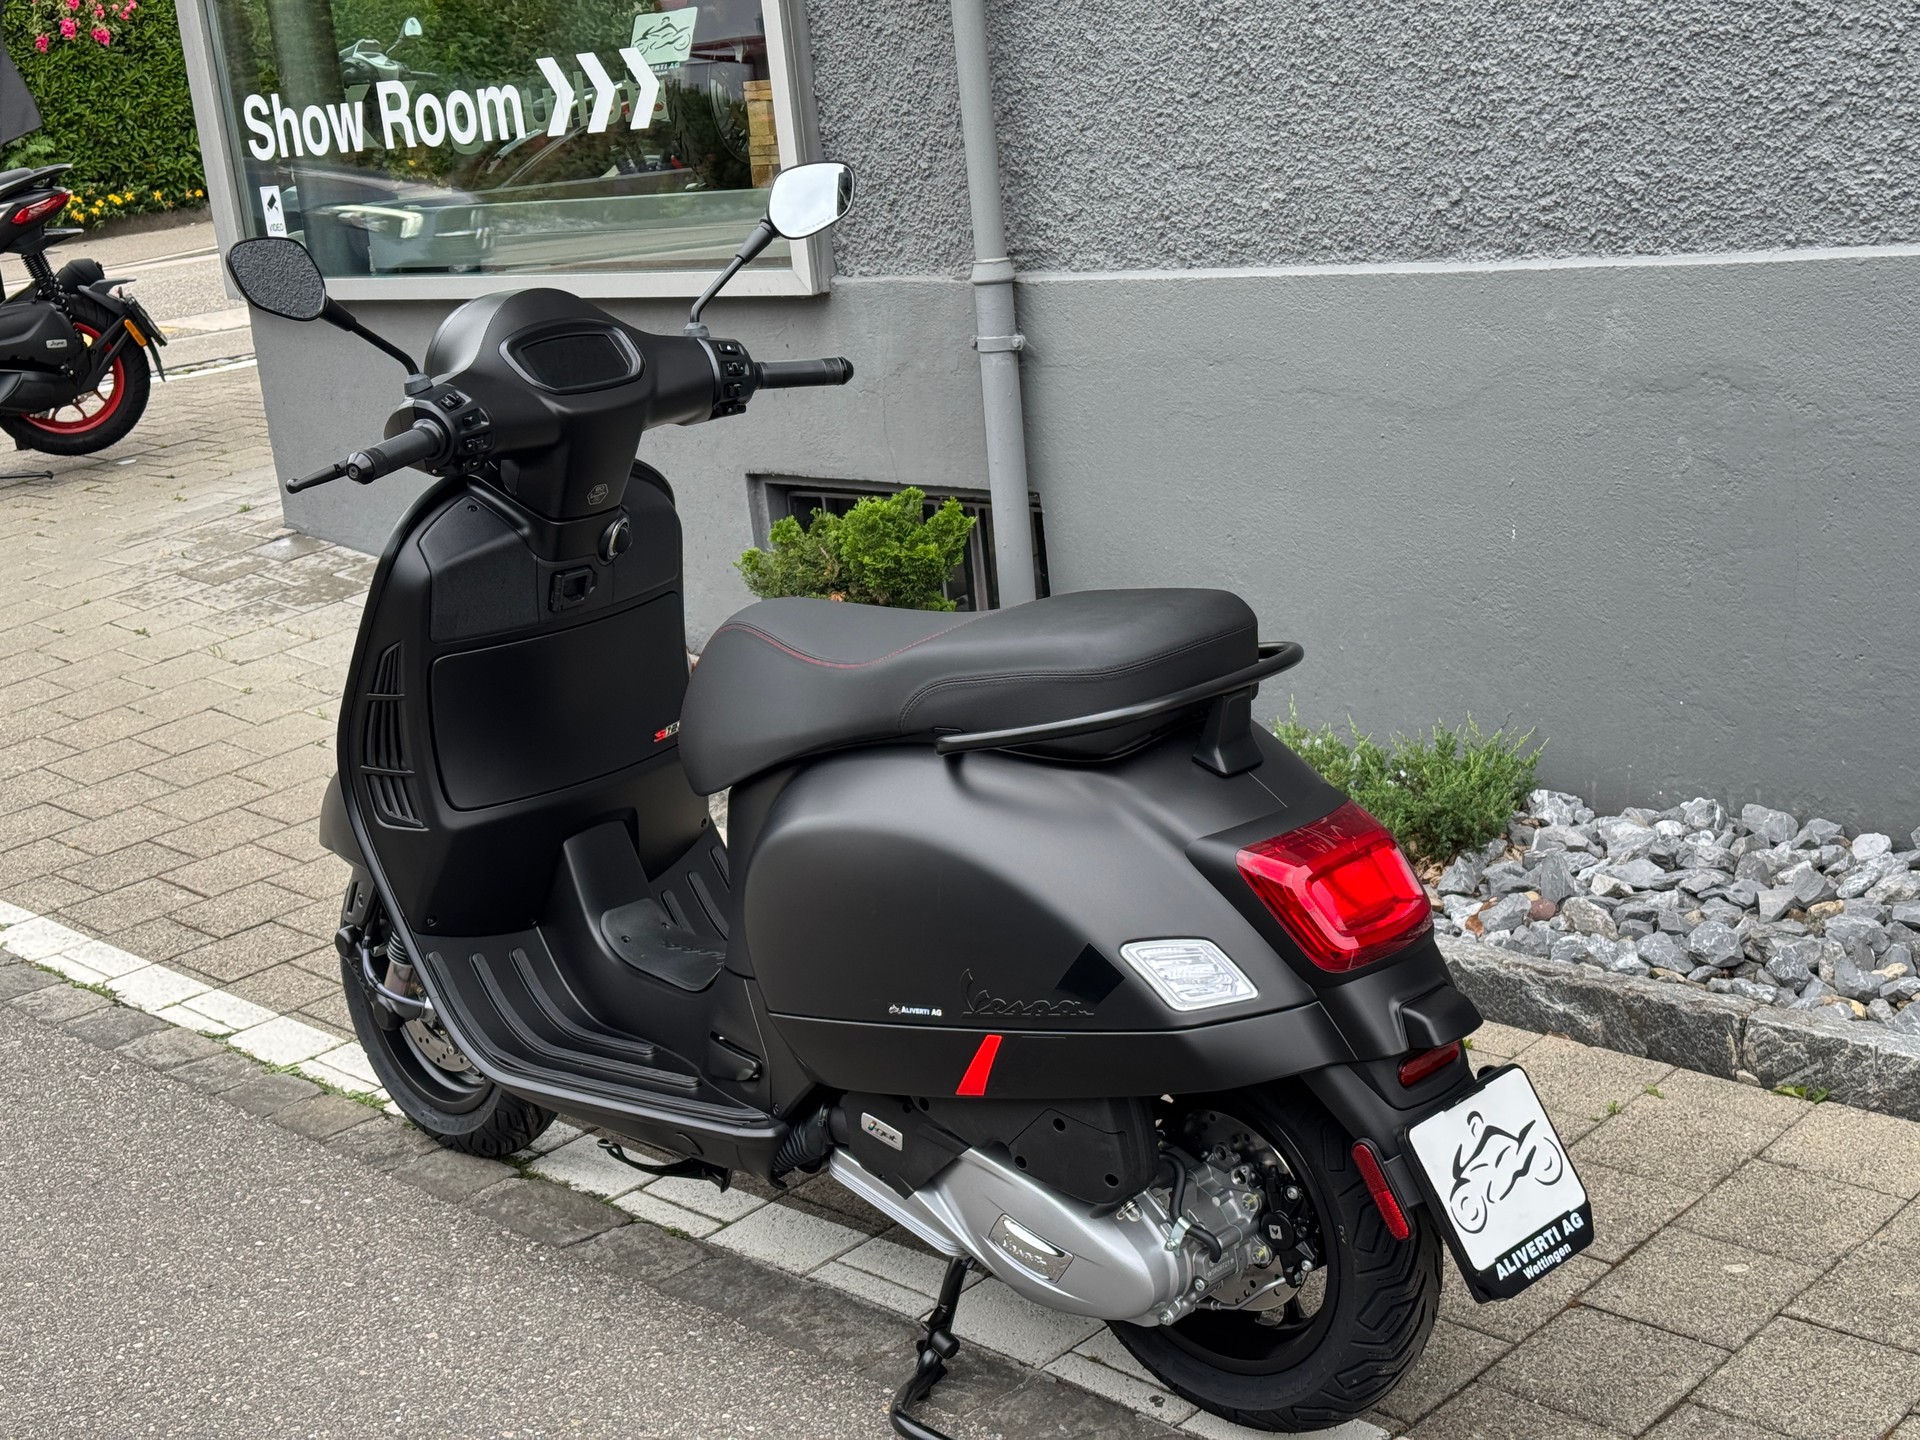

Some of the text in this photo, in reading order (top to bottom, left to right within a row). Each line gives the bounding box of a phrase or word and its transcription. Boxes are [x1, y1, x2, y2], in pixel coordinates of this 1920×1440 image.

[243, 93, 364, 161] Show
[376, 80, 526, 149] Room
[268, 222, 285, 232] VIDEO
[653, 720, 680, 743] S12
[960, 968, 1095, 1017] Vespa
[930, 1007, 943, 1018] AG
[1495, 1212, 1585, 1281] ALIVERTI AG
[1522, 1243, 1572, 1280] Wettingen
